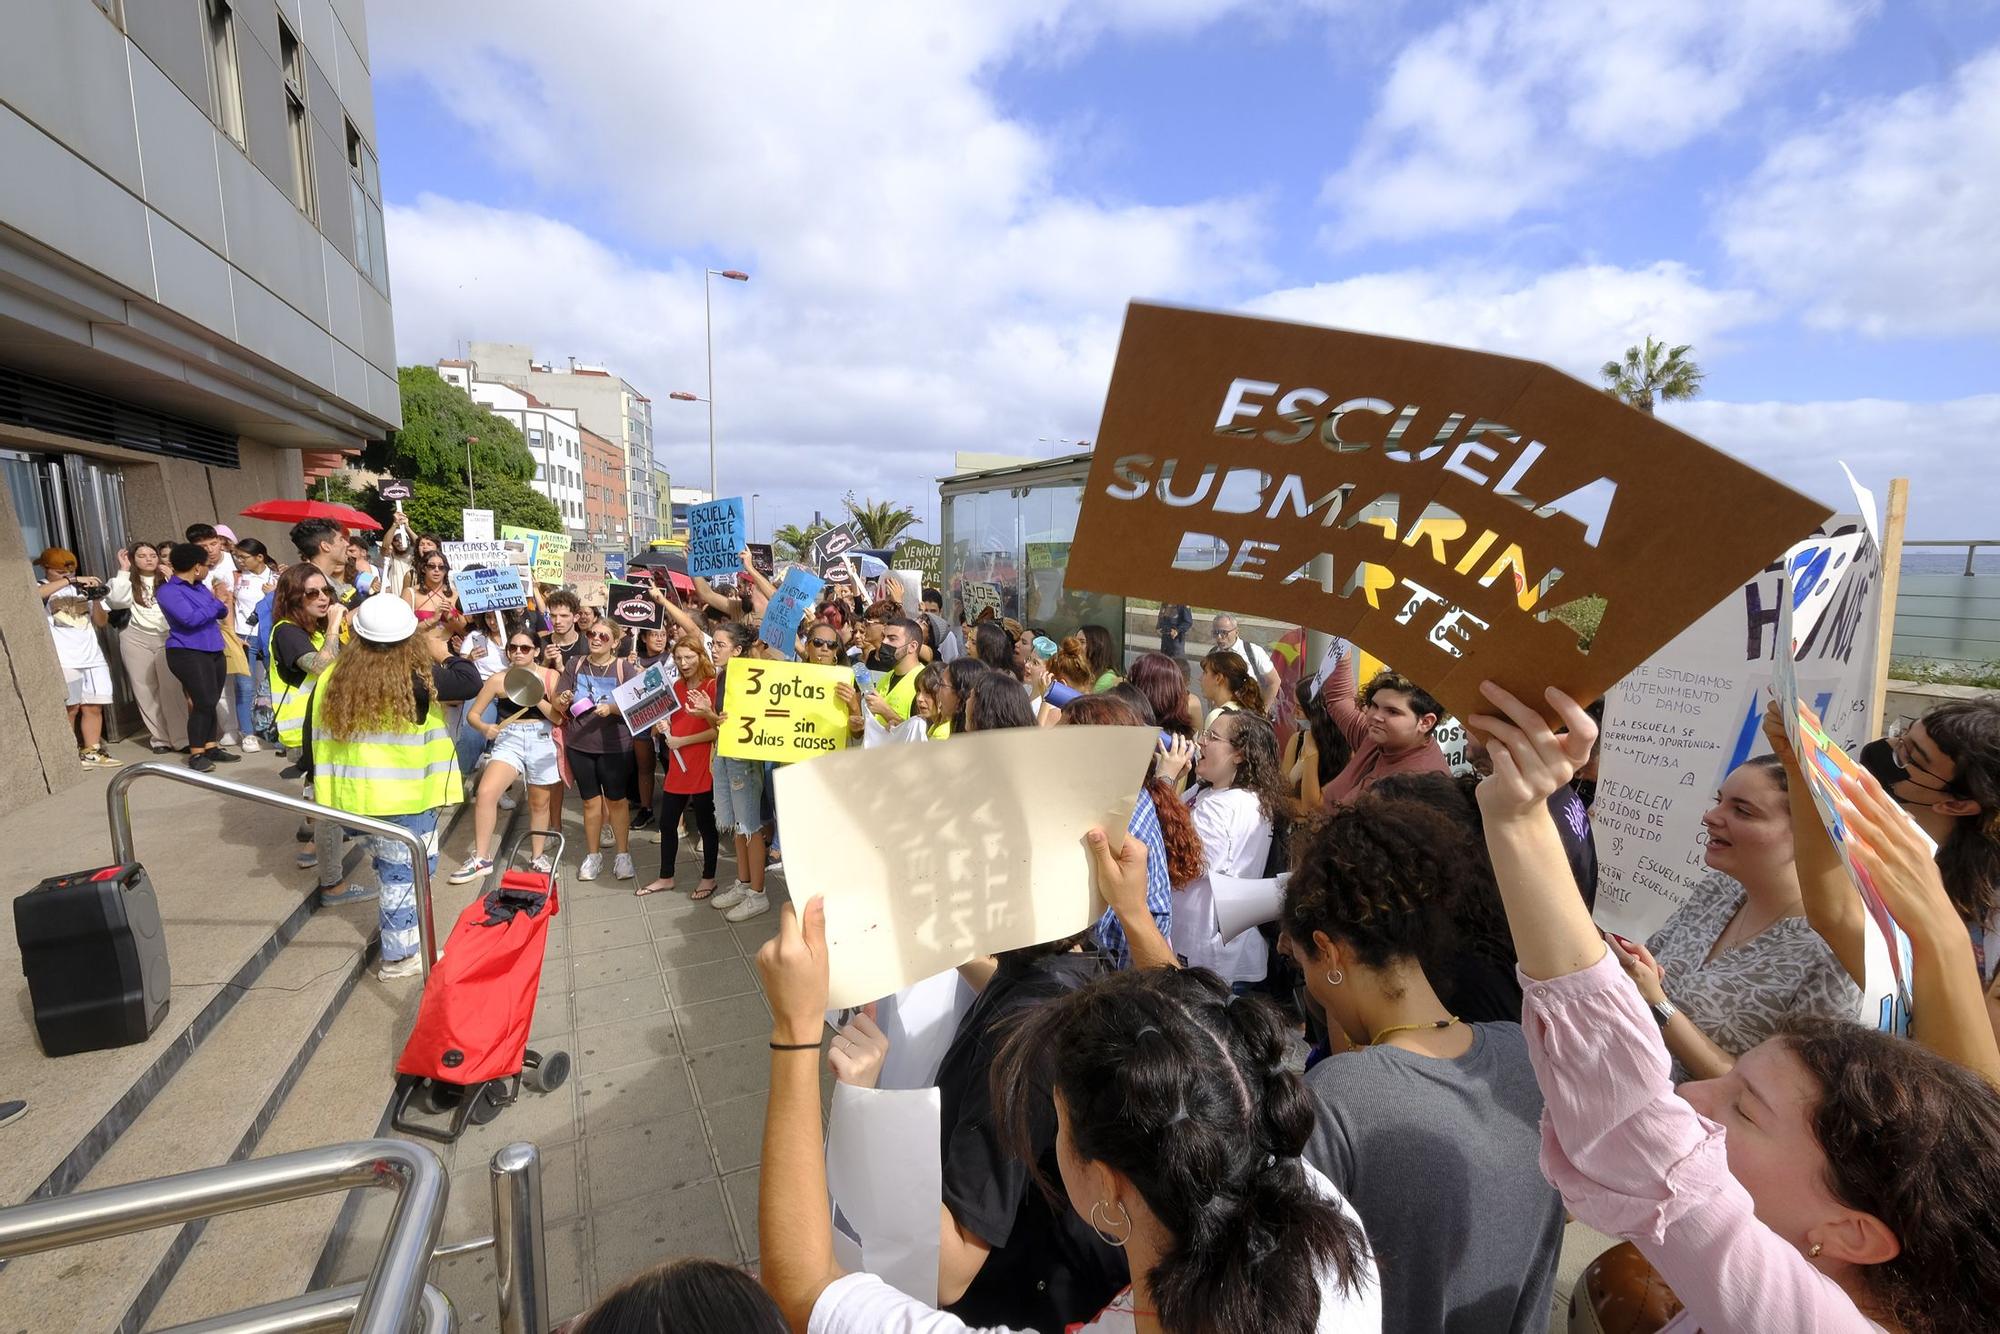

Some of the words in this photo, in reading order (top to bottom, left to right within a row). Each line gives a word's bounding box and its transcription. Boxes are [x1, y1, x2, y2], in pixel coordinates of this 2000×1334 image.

[1213, 377, 1618, 547] ESCUELA
[691, 505, 735, 525] ESCUELA
[692, 526, 702, 541] DE
[708, 521, 735, 538] ARTE
[462, 542, 489, 552] CLASES
[490, 541, 501, 551] DE
[693, 536, 735, 555] ESCUELA
[1105, 454, 1608, 655] SUBMARINA
[566, 562, 598, 574] SOMOS
[576, 553, 592, 563] NO
[694, 553, 739, 573] DESASTRE
[456, 573, 472, 581] Con
[474, 568, 499, 580] AGUA
[475, 578, 498, 586] CLASE
[493, 582, 518, 592] LUGAR
[1171, 531, 1281, 580] DE
[1280, 551, 1491, 660] ARTE
[468, 602, 482, 612] EL
[486, 596, 524, 610] ARTE
[746, 668, 765, 695] 3
[769, 675, 825, 706] gotas
[1657, 667, 1733, 690] ESTUDIAMOS
[1623, 692, 1642, 705] NO
[1655, 698, 1702, 716] DAMOS
[737, 716, 756, 744] 3
[793, 736, 836, 751] clases
[794, 718, 816, 733] sin
[1612, 717, 1626, 727] LA
[1631, 720, 1676, 734] ESCUELA
[1682, 727, 1695, 737] SE
[1624, 747, 1635, 755] LA
[1634, 750, 1680, 769] TUMBA
[1601, 779, 1620, 797] ME
[1620, 785, 1673, 811] DUELEN
[1647, 813, 1665, 827] DE
[1623, 822, 1662, 843] RUIDO
[1686, 850, 1700, 866] LA
[1637, 855, 1680, 884] ESCUELA
[1632, 871, 1668, 897] ESCUELA
